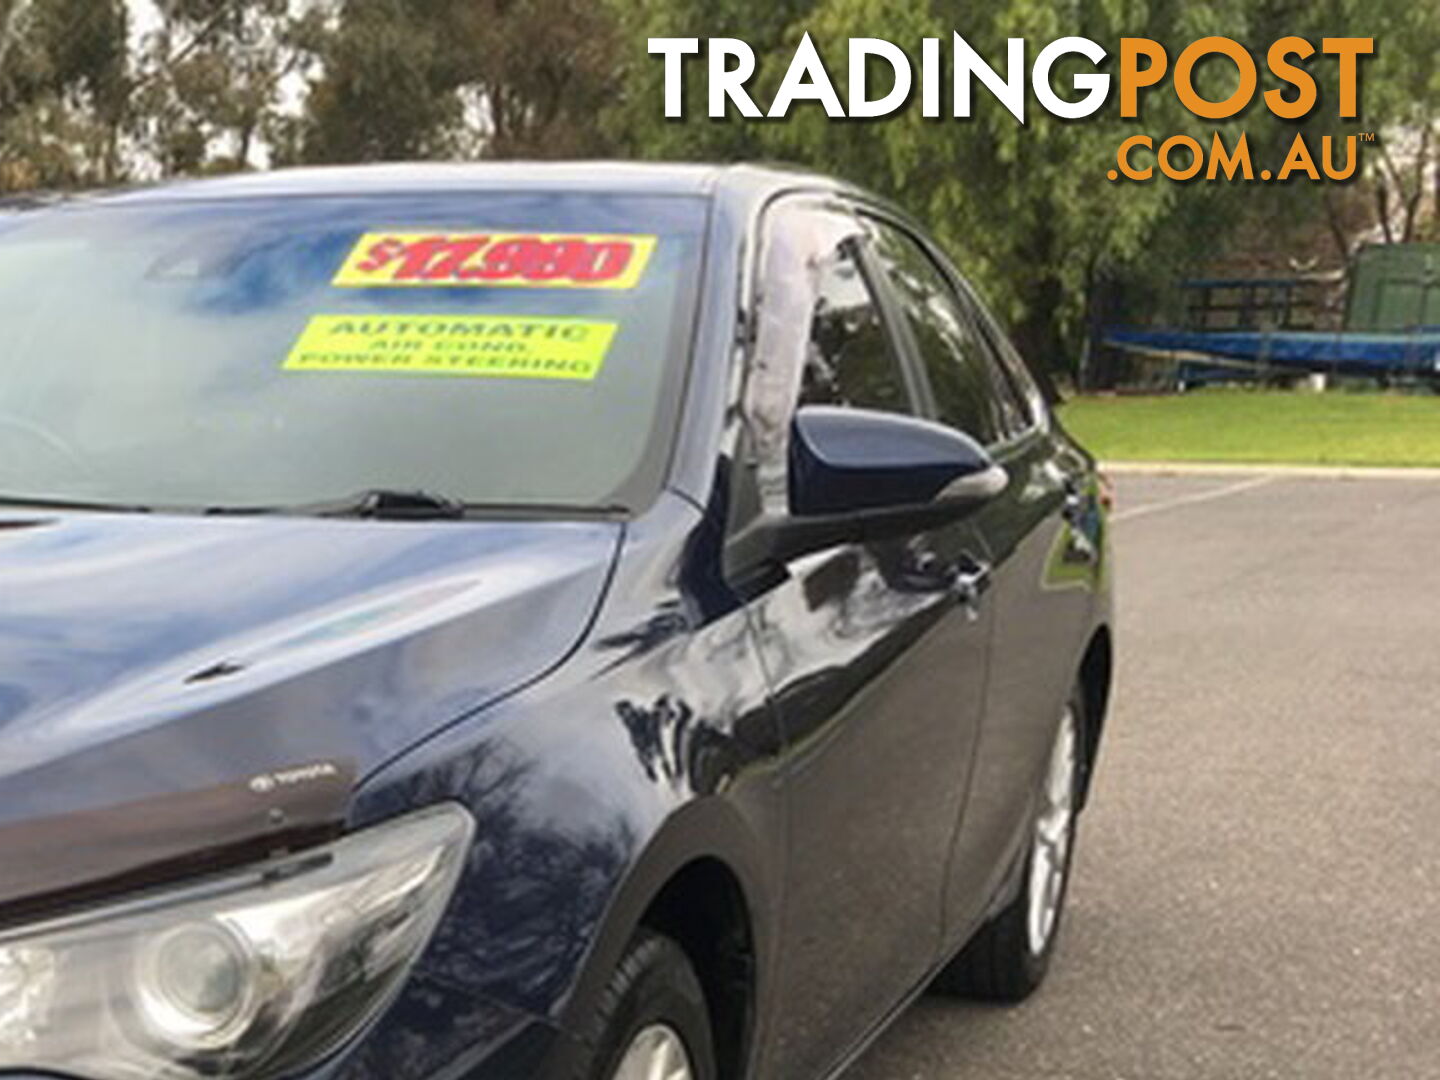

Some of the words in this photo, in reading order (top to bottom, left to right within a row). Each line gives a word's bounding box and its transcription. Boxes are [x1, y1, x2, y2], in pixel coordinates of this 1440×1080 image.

[328, 322, 588, 341] AUTOMATIC
[369, 340, 423, 351] AIR
[298, 353, 412, 364] POWER
[424, 354, 592, 373] STEERING
[274, 763, 337, 784] TOYOTA
